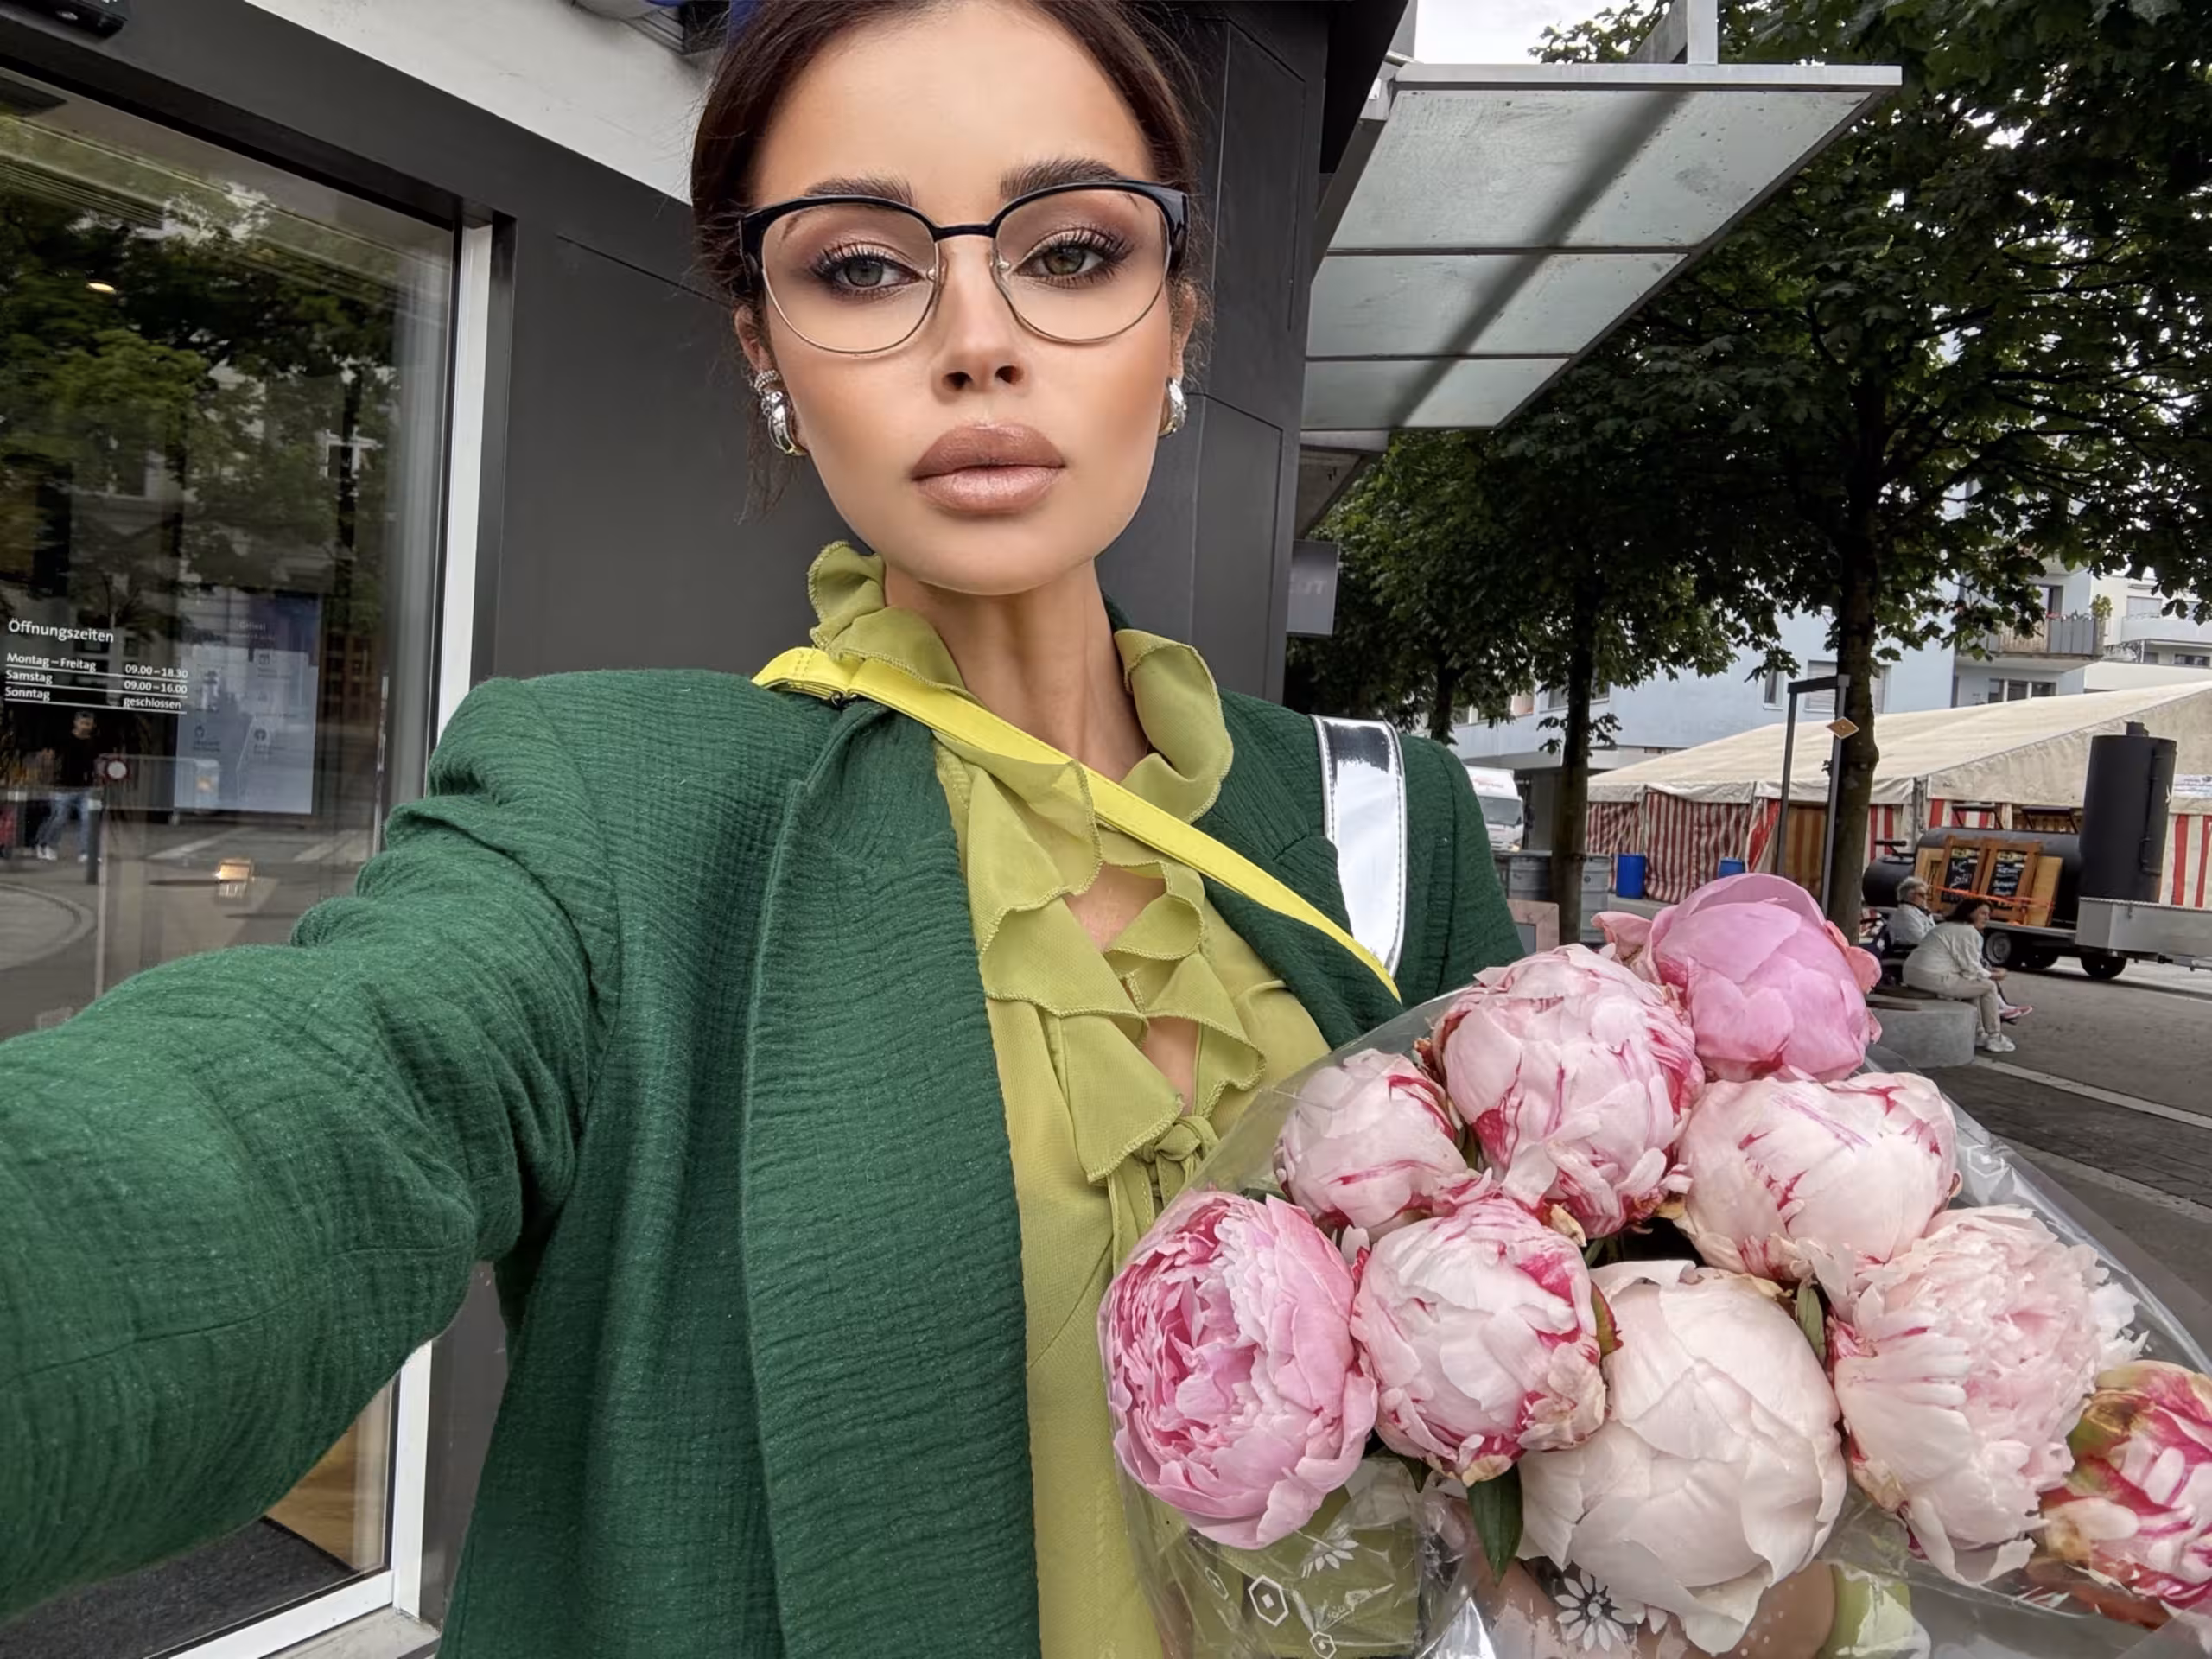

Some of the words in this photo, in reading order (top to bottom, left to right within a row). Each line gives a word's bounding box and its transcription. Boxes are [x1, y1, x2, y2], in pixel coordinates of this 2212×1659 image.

[8, 617, 114, 643] Öffnungszeiten
[6, 652, 50, 668] Montag
[60, 658, 97, 673] Freitag
[125, 664, 153, 676] 09.00
[161, 667, 188, 679] 18.30
[5, 669, 53, 685] Samstag
[124, 680, 152, 691] 09.00
[161, 683, 188, 694] 16.00
[4, 686, 50, 702] Sonntag
[123, 696, 181, 710] geschlossen
